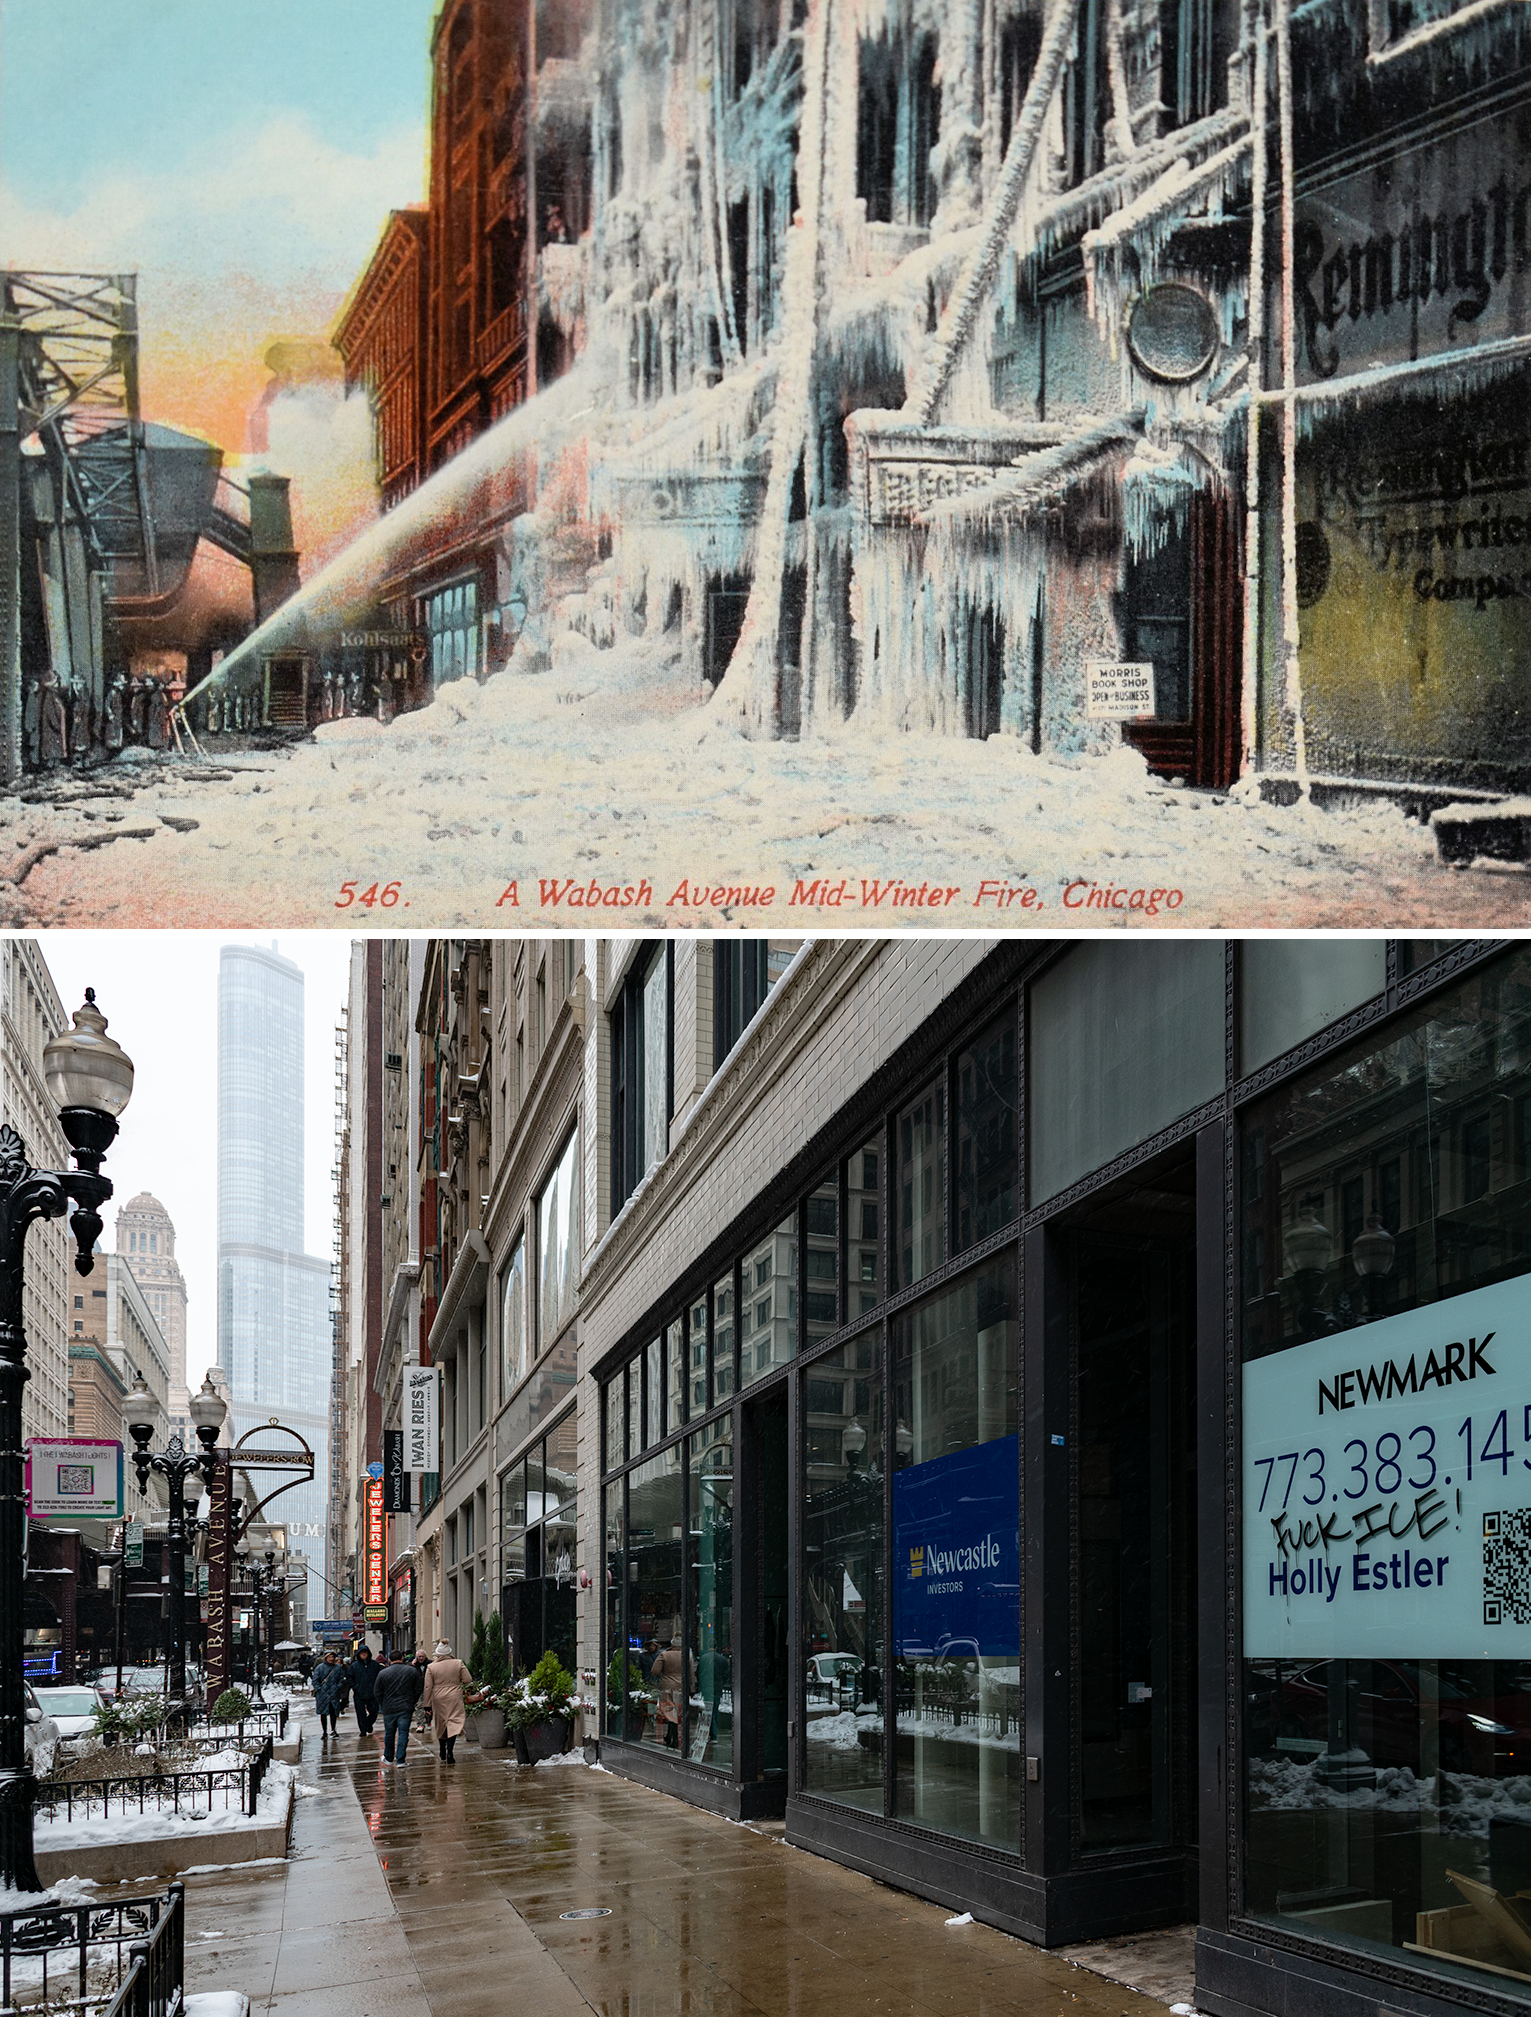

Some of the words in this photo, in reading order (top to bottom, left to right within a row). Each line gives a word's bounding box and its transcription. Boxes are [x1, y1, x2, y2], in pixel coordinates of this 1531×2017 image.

[1091, 680, 1117, 689] BOOK
[1121, 679, 1148, 688] SHOP
[1099, 668, 1141, 678] MORRIS
[1114, 690, 1150, 702] BUSINESS
[1318, 1331, 1498, 1416] NEWMARK
[411, 1389, 425, 1425] RIES
[231, 1453, 288, 1463] JEWELERS
[289, 1454, 315, 1465] ROW
[411, 1428, 425, 1468] IWAN
[209, 1465, 228, 1564] AVENUE
[368, 1481, 385, 1550] JEWELERS
[1271, 1511, 1352, 1558] FUCK
[1351, 1488, 1463, 1546] ICE!
[926, 1534, 1001, 1576] Newcastle
[1269, 1554, 1342, 1603] Holly
[1352, 1549, 1450, 1592] Estler
[368, 1552, 383, 1604] CENTER
[926, 1581, 964, 1595] INVESTORS
[206, 1589, 225, 1689] WABASH
